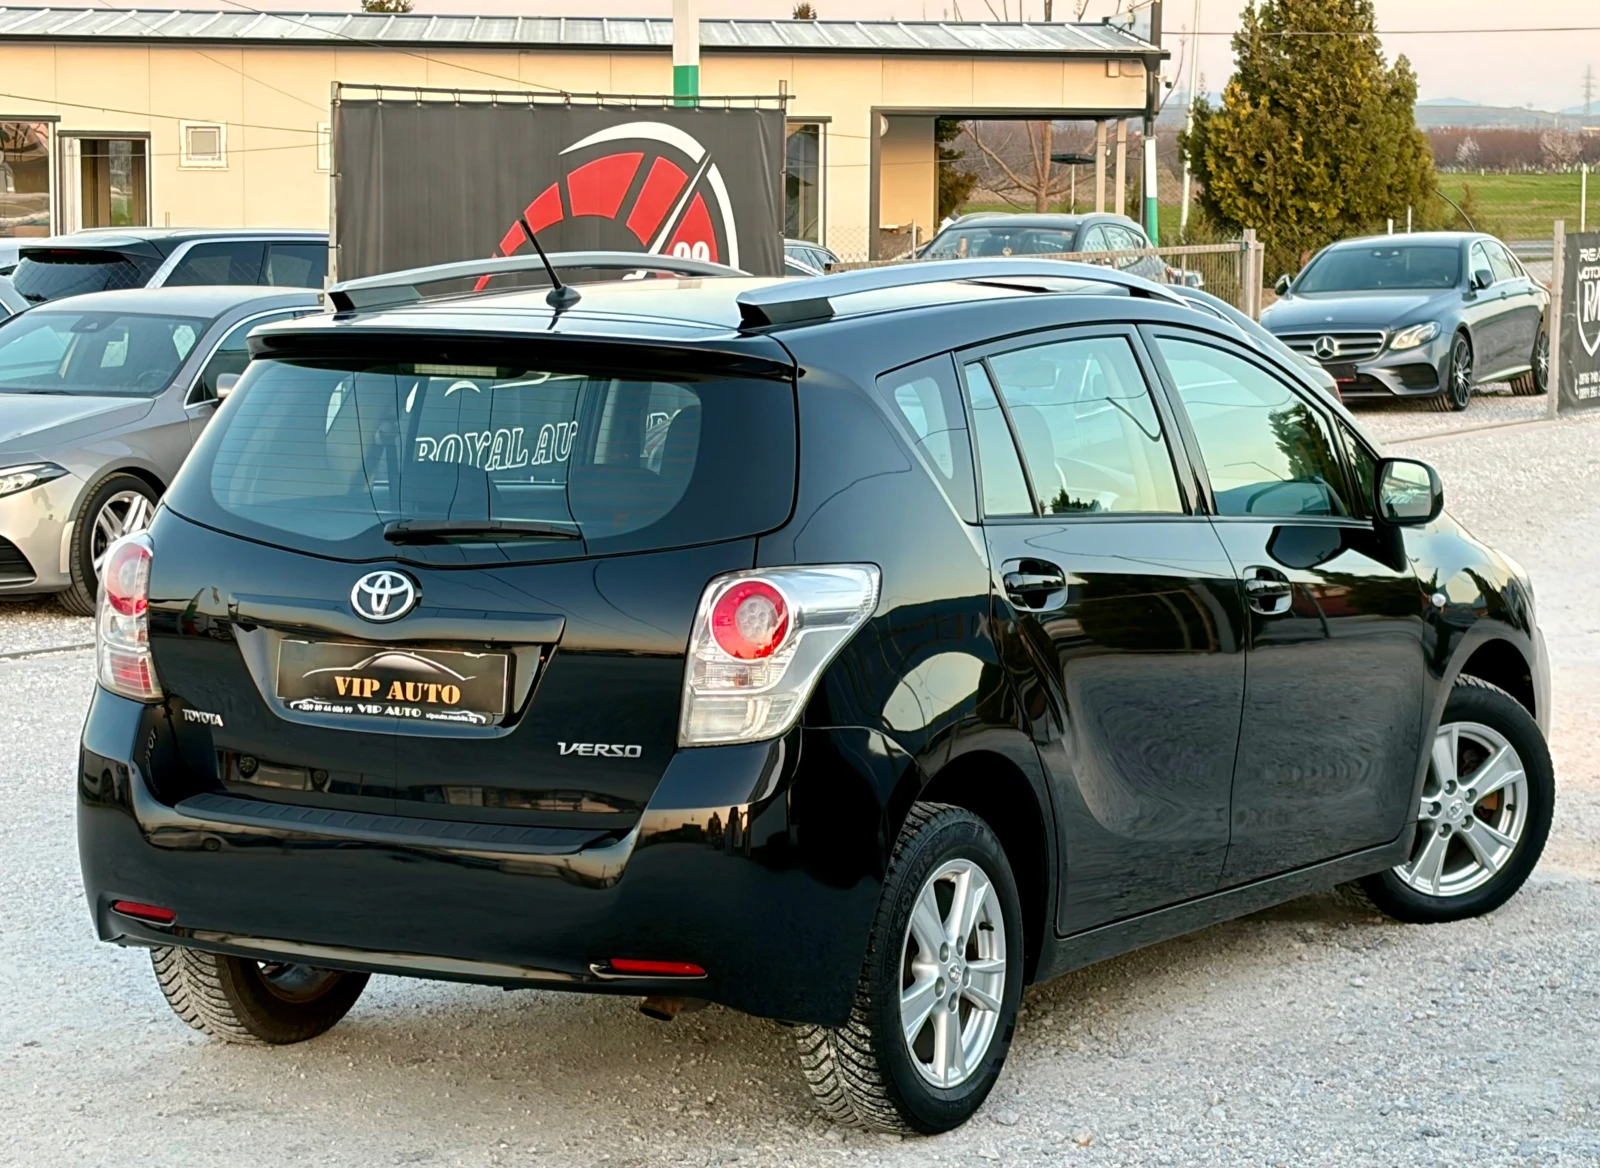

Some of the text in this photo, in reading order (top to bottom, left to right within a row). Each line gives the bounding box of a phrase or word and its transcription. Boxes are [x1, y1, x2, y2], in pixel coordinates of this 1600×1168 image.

[415, 428, 528, 471] ROYAL
[334, 676, 461, 705] VIP AUTO
[182, 708, 224, 727] TOYOTA
[357, 703, 422, 718] VIP AUTO
[557, 741, 642, 758] VERSO
